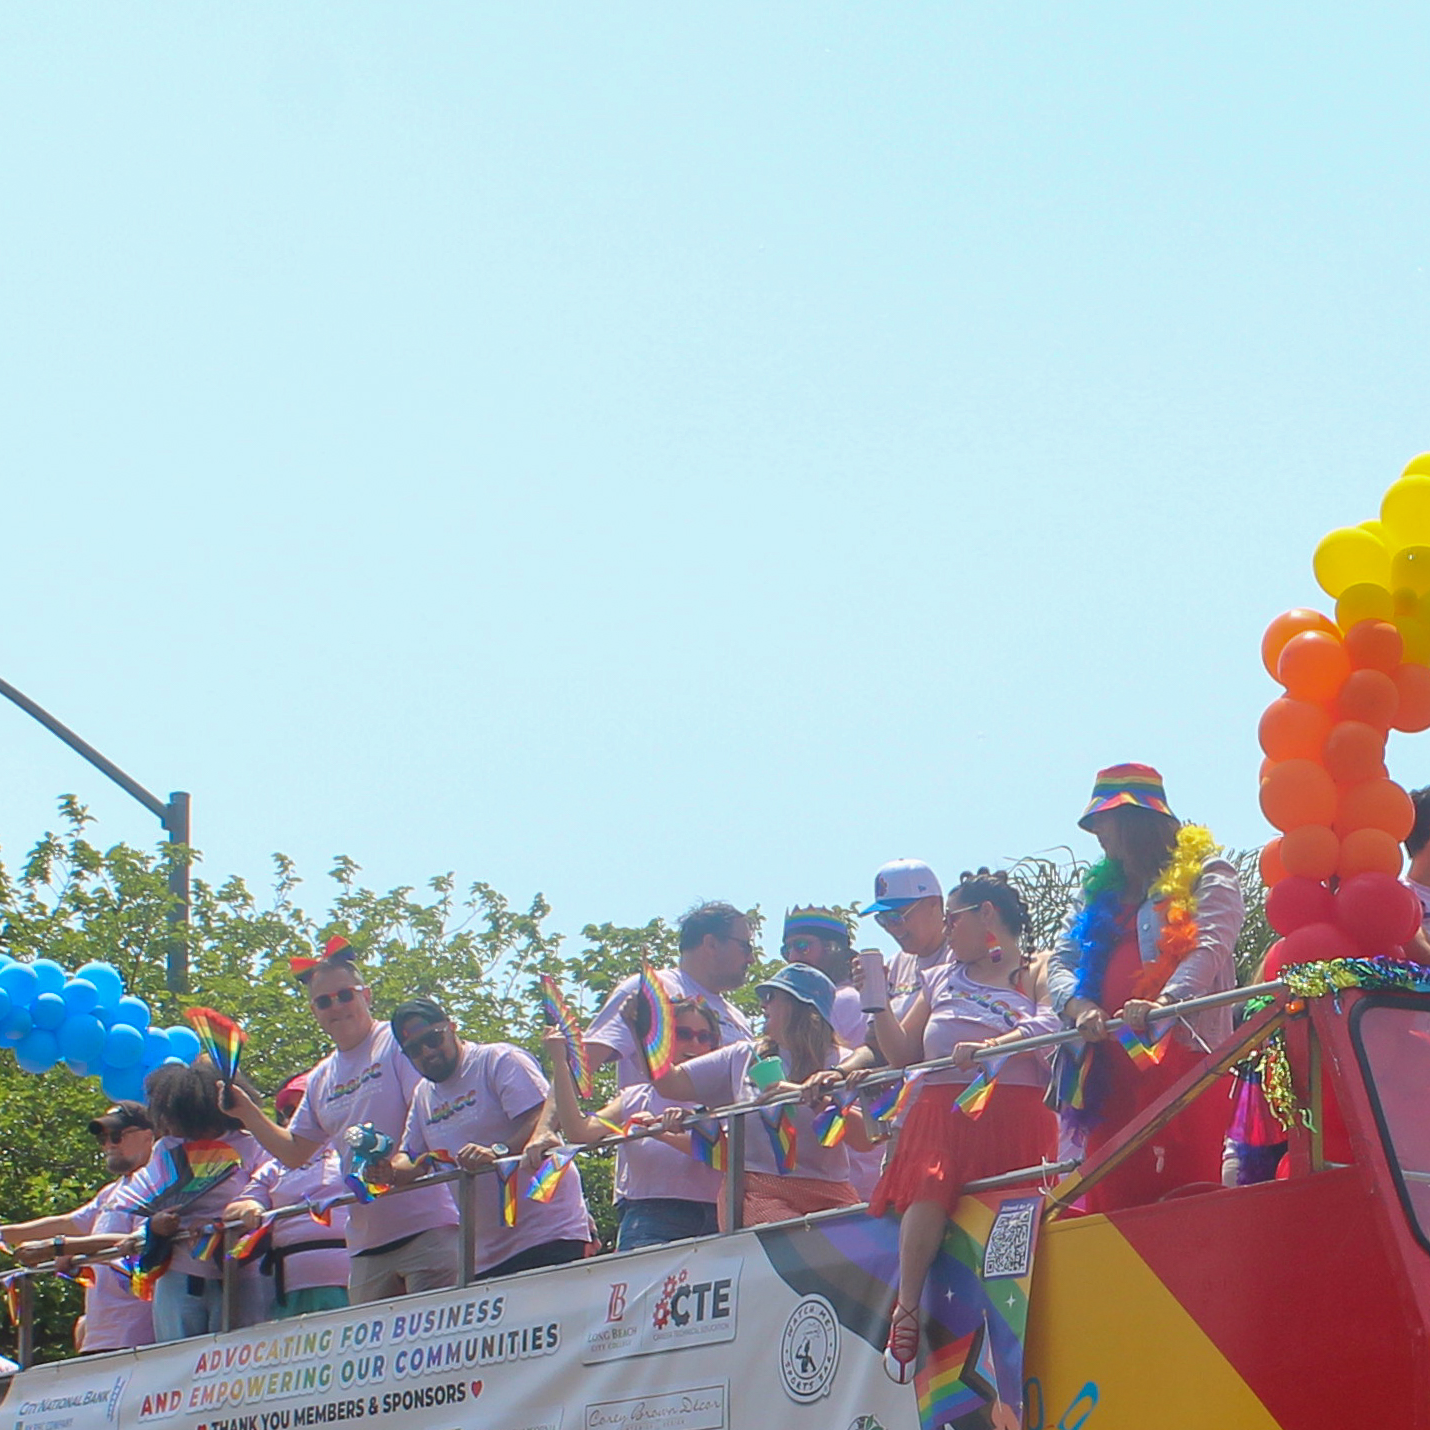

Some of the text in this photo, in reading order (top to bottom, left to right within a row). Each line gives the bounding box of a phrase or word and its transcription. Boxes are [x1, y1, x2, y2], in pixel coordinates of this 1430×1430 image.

[672, 1278, 733, 1327] CTE
[194, 1296, 506, 1376] ADVOCATING FOR BUSINESS
[587, 1326, 638, 1343] LONG BEACH
[787, 1305, 815, 1337] WATCH
[139, 1322, 559, 1417] AND EMPOWERING OUR COMMUNITIES
[785, 1361, 815, 1390] SPORTS
[83, 1390, 111, 1405] BANK
[294, 1398, 365, 1428] MEMBERS
[368, 1396, 379, 1416] &
[382, 1381, 467, 1414] SPONSORS
[630, 1401, 678, 1422] Brown
